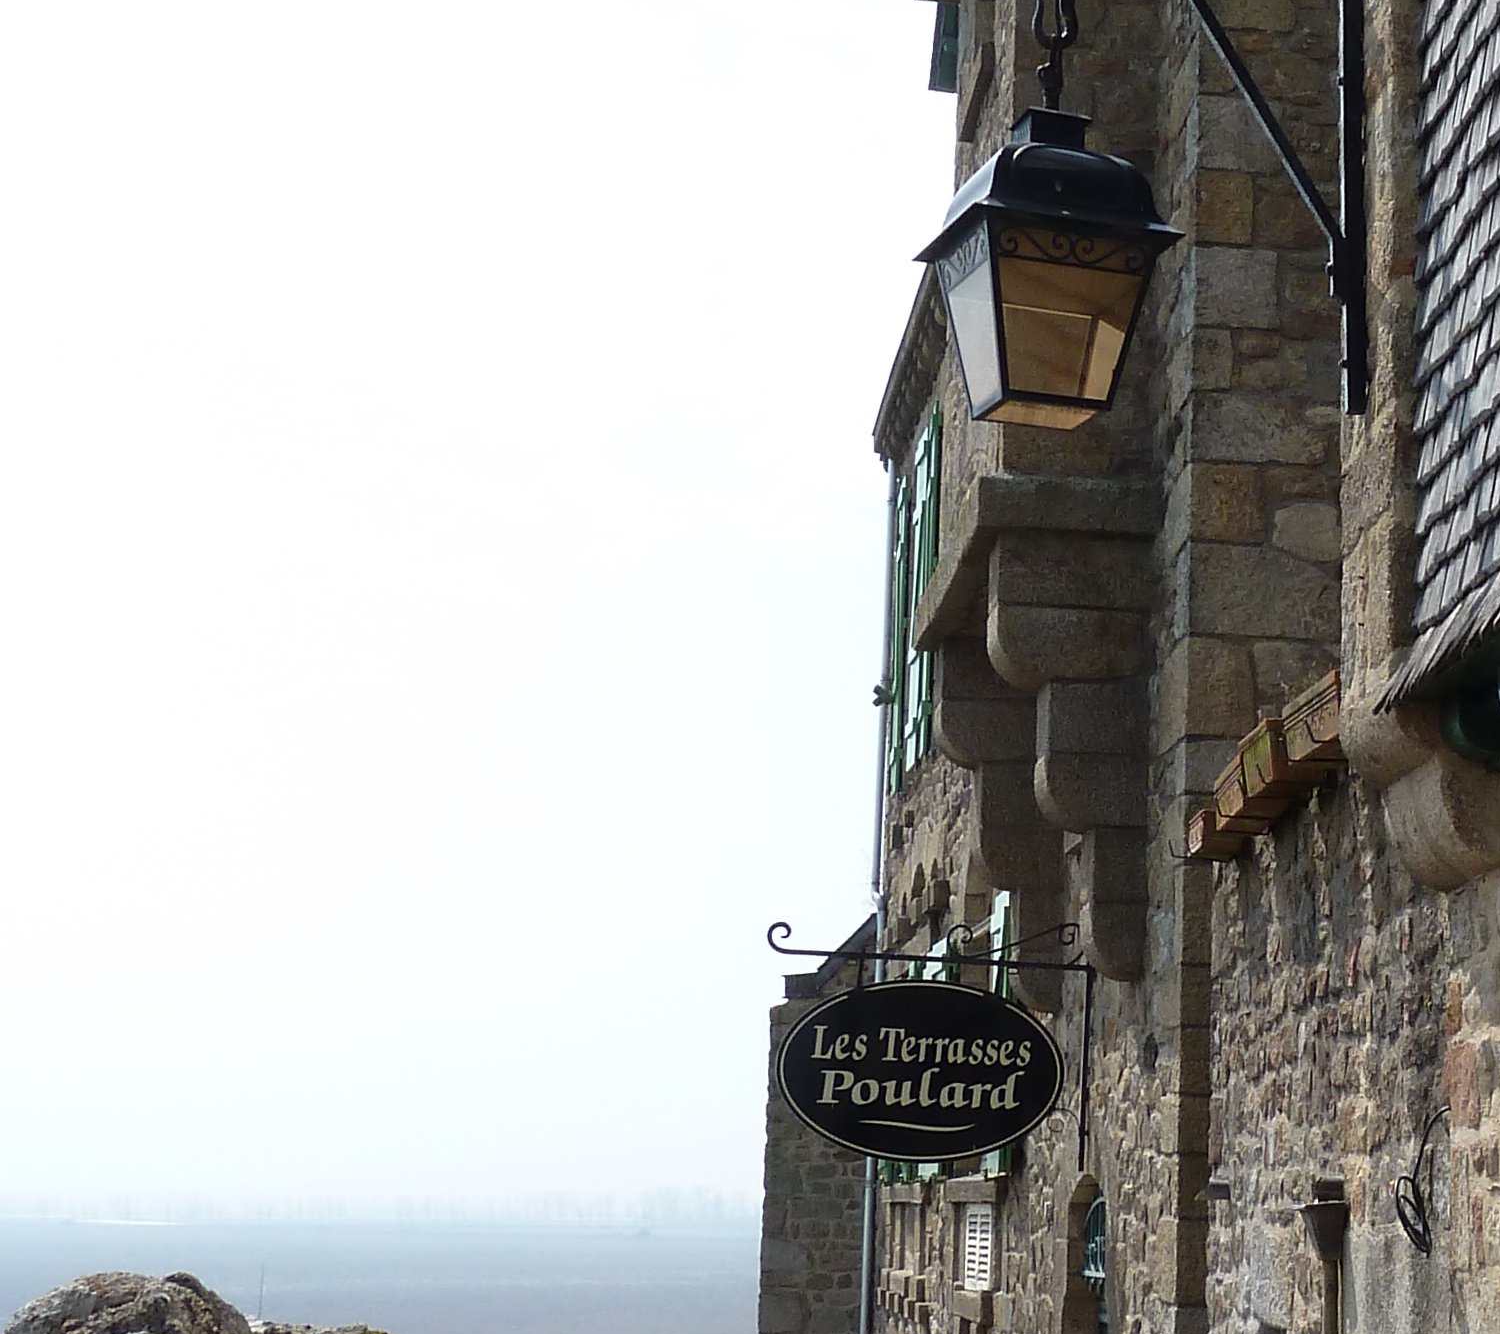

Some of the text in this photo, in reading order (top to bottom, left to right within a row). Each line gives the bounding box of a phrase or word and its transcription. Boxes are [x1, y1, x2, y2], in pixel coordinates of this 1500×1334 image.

[811, 1024, 1031, 1066] Les Terrasses
[817, 1068, 1025, 1110] Poulard
